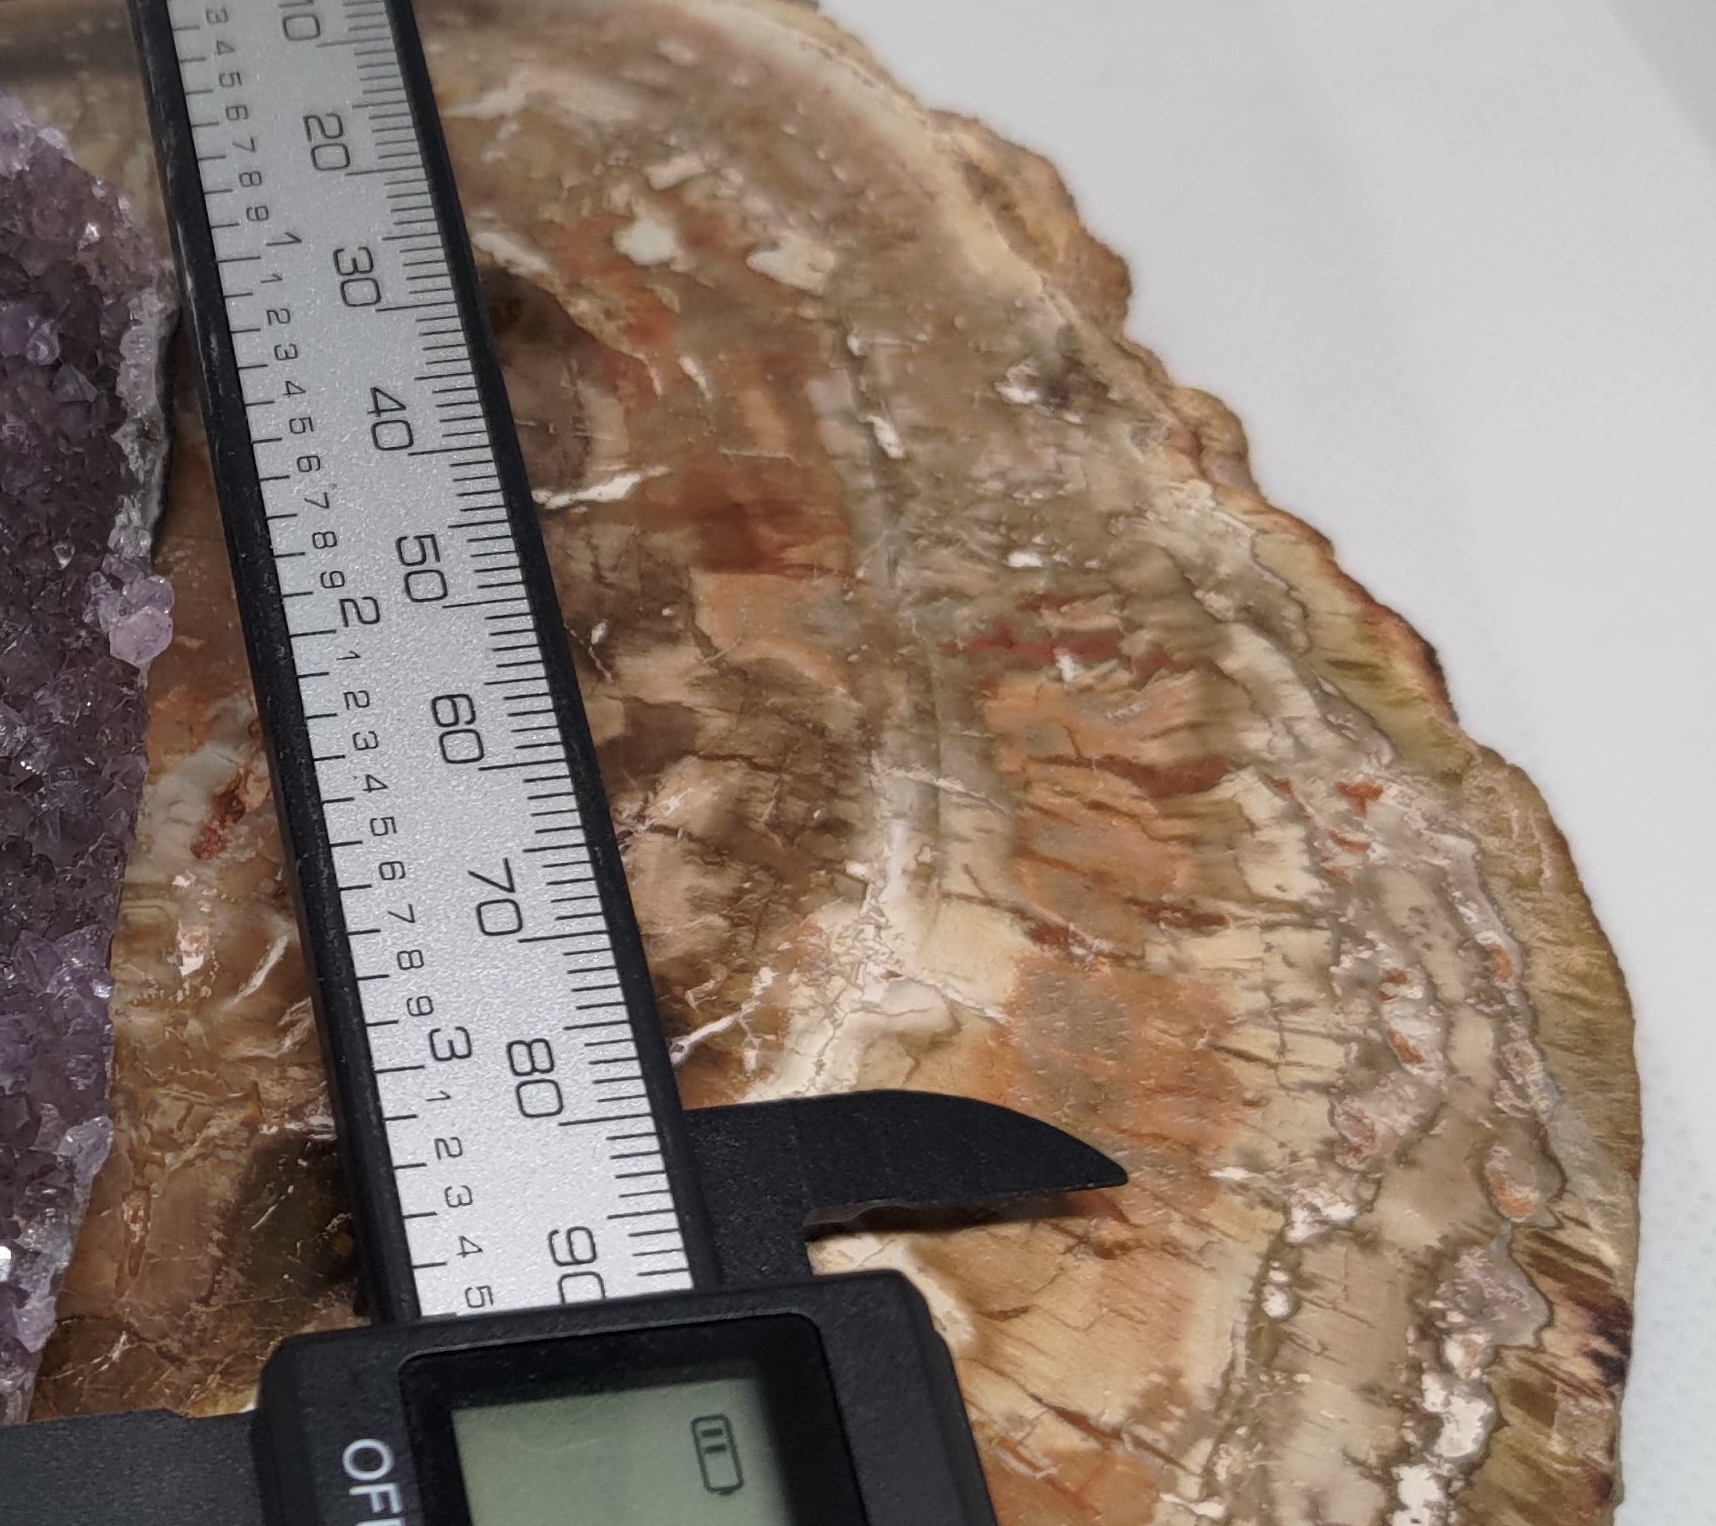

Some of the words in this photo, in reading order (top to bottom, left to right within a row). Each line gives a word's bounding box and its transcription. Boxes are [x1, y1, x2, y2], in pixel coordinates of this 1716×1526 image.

[206, 7, 229, 24] 3
[215, 40, 235, 55] 4
[219, 70, 242, 87] 5
[225, 105, 249, 121] 6
[232, 137, 257, 154] 7
[239, 171, 262, 187] 8
[246, 205, 269, 221] 9
[266, 308, 290, 325] 2
[274, 343, 298, 361] 3
[284, 381, 306, 398] 4
[289, 417, 314, 434] 5
[297, 455, 320, 472] 6
[304, 492, 330, 509] 7
[312, 531, 337, 549] 8
[320, 571, 345, 588] 9
[303, 113, 351, 171] 20
[333, 246, 382, 307] 30
[367, 386, 414, 451] 40
[395, 533, 448, 603] 50
[431, 693, 484, 764] 60
[468, 857, 523, 936] 70
[506, 1038, 564, 1118] 80
[339, 596, 381, 628] 2
[343, 690, 370, 710] 2
[353, 731, 379, 751] 3
[363, 774, 388, 793] 4
[370, 816, 397, 836] 5
[378, 861, 406, 880] 6
[388, 904, 415, 923] 7
[397, 950, 424, 970] 8
[406, 996, 434, 1017] 9
[428, 1026, 472, 1062] 3
[434, 1137, 463, 1160] 2
[444, 1185, 473, 1208] 3
[457, 1236, 483, 1258] 4
[464, 1284, 494, 1309] 5
